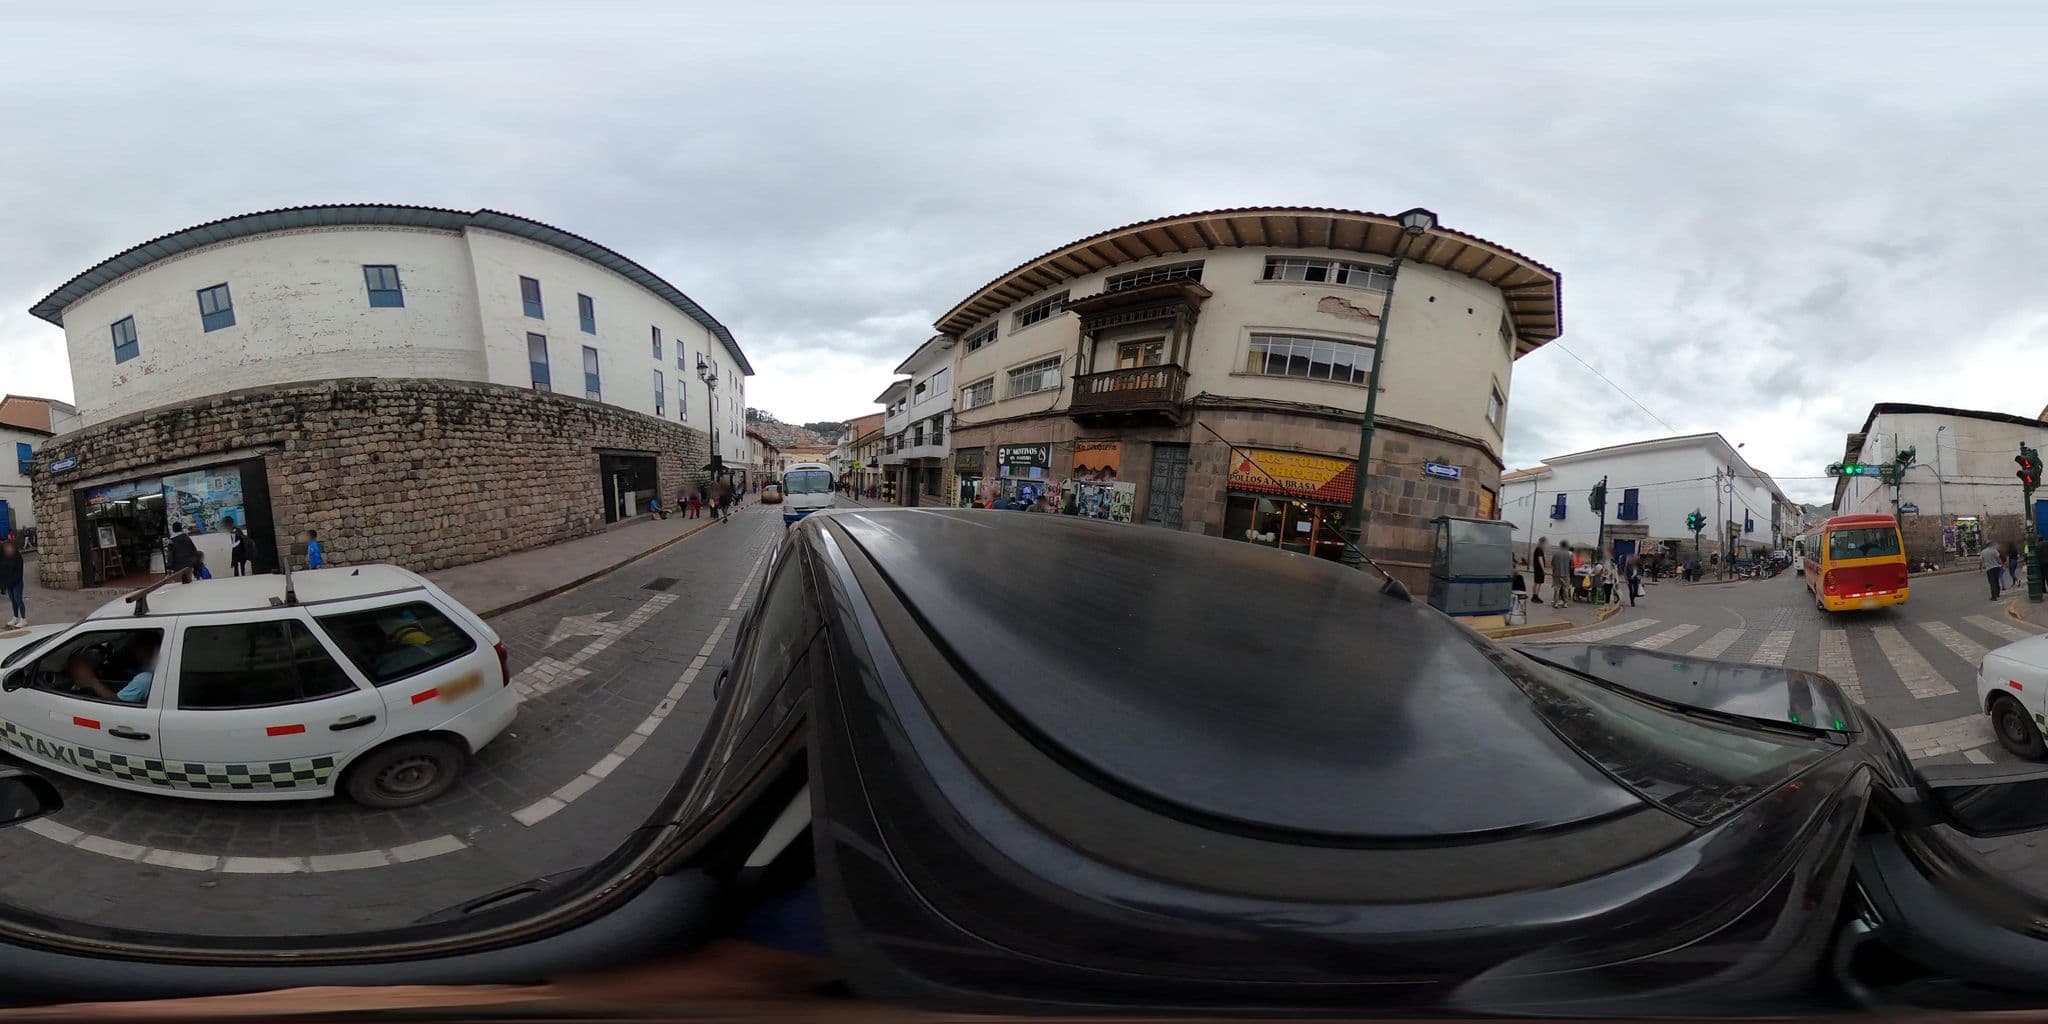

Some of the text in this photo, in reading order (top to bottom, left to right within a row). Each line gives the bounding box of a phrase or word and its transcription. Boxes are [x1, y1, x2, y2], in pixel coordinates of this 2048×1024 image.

[1255, 452, 1285, 465] LOS
[1229, 473, 1316, 490] POLLOS A LA BRASA
[1265, 466, 1331, 482] CHICKEN
[20, 731, 79, 766] TAXI
